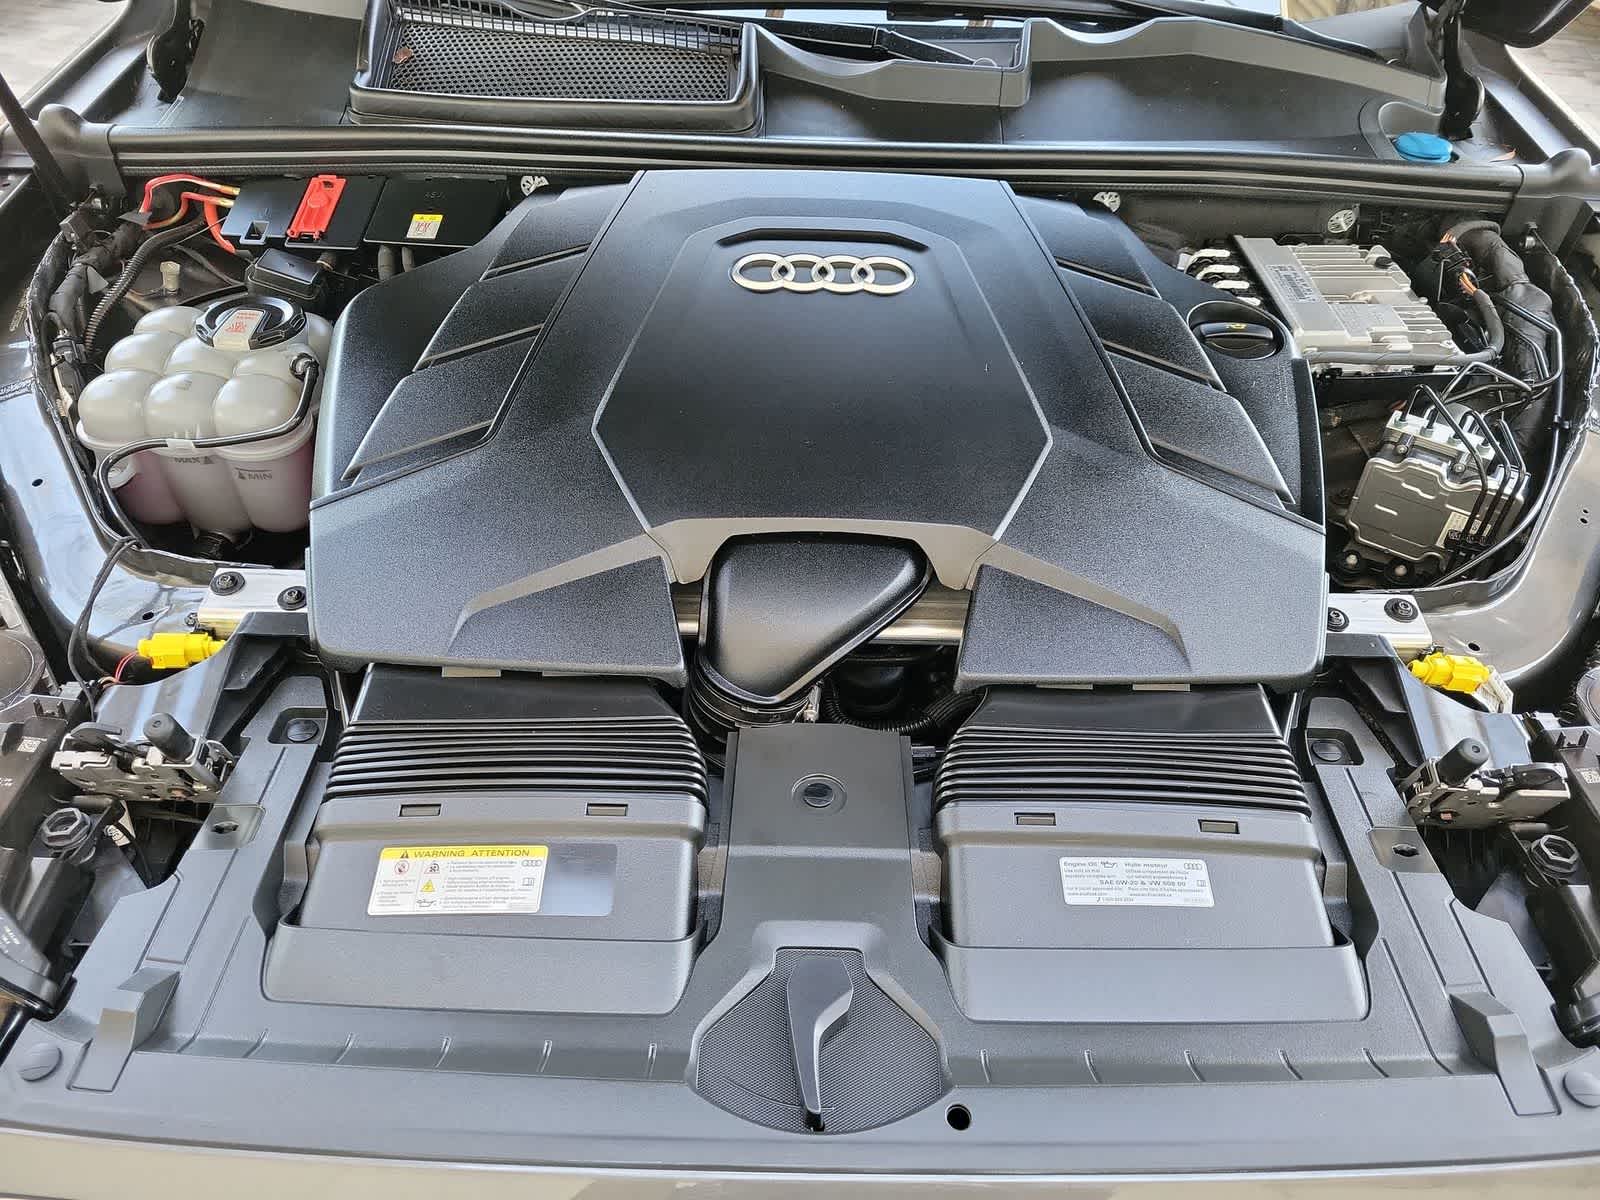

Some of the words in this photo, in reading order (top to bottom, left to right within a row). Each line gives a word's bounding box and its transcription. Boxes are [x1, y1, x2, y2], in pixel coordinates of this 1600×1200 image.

[173, 456, 201, 464] MAX
[247, 472, 273, 481] MIN
[414, 850, 465, 858] WARNING
[471, 849, 530, 857] ATTENTION
